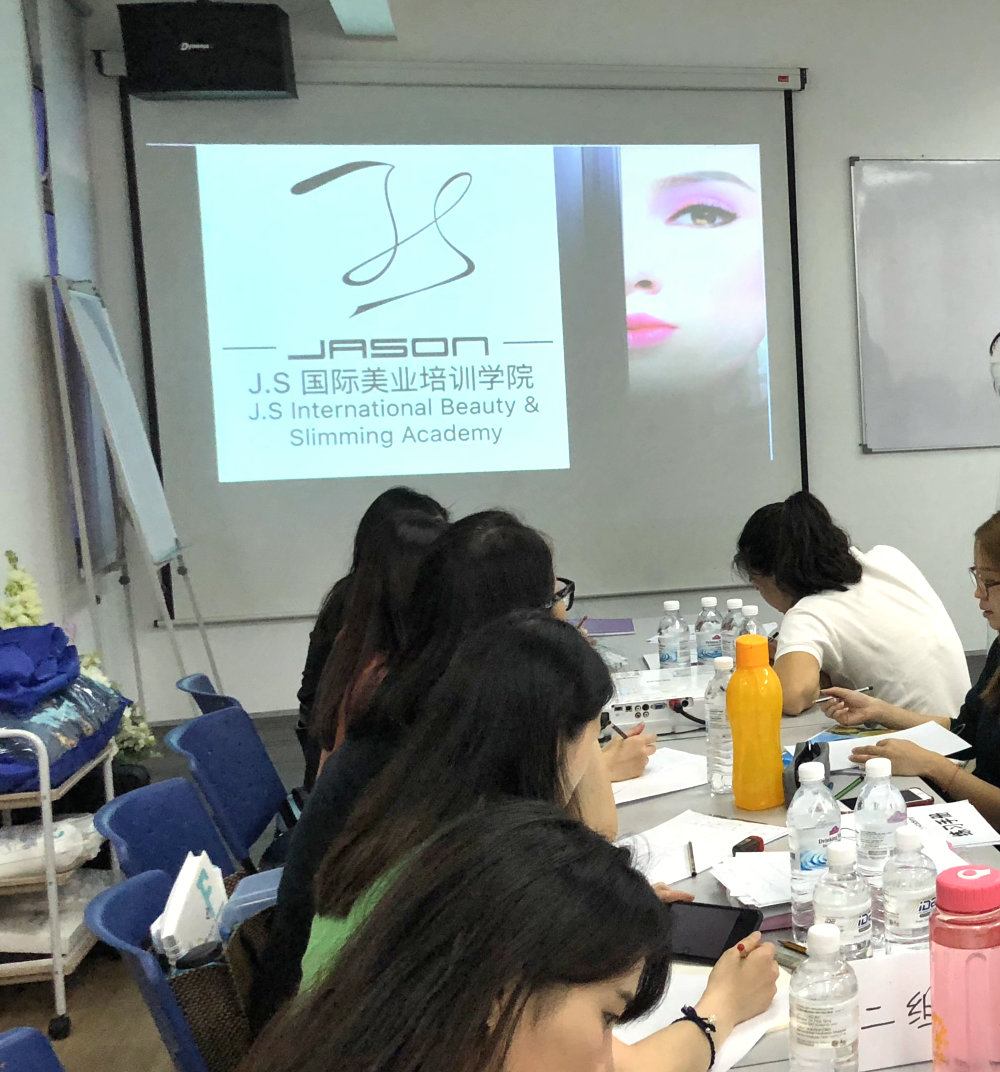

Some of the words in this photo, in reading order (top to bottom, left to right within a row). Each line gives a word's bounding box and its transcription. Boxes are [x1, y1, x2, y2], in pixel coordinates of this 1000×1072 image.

[287, 336, 489, 360] JASON
[248, 372, 291, 395] J.S
[301, 363, 535, 395] 国际美业培训学院
[248, 402, 283, 420] J.S
[291, 398, 433, 419] International
[441, 397, 516, 418] Beauty
[524, 396, 540, 413] &
[290, 427, 393, 448] Slimming
[402, 424, 503, 445] Academy
